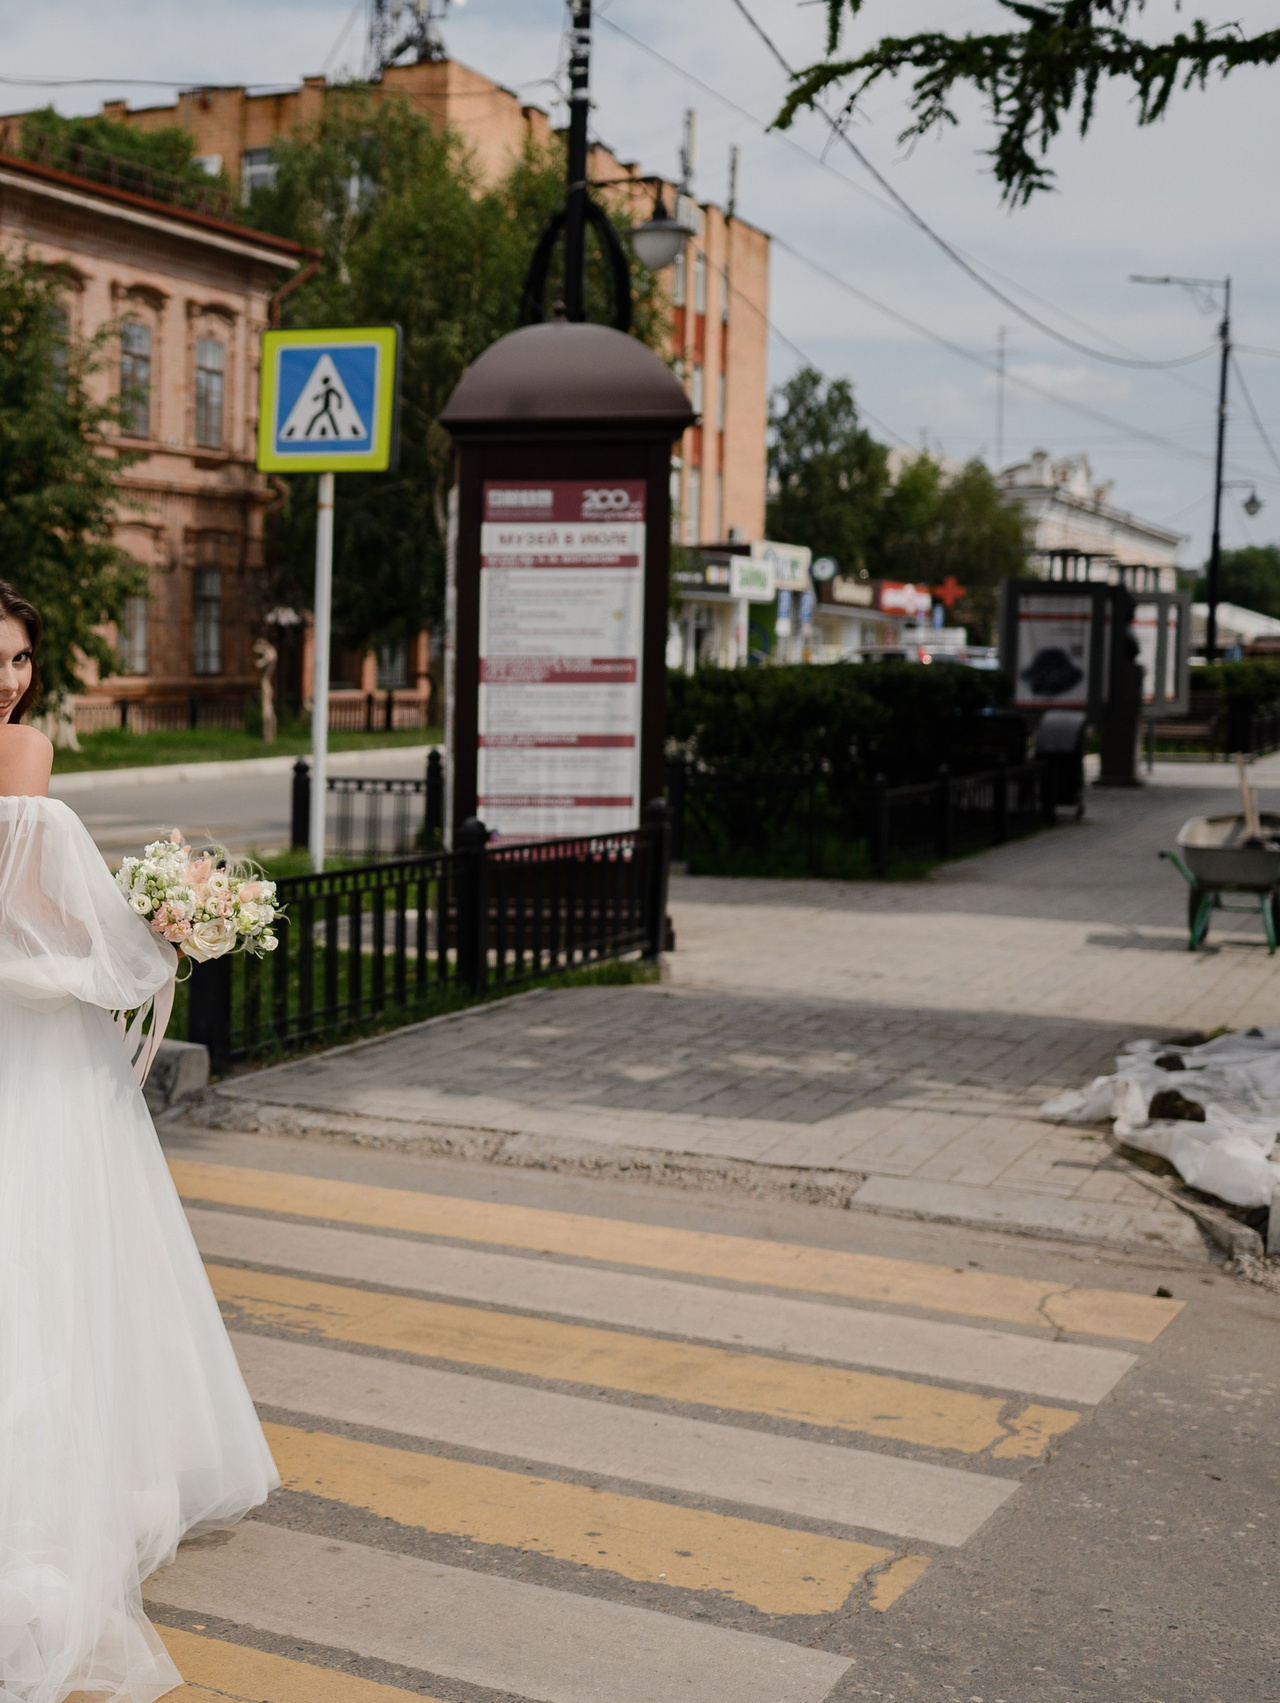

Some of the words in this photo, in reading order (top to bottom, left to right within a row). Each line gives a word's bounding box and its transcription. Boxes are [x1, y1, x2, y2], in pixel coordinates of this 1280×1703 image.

[582, 488, 631, 511] 200
[499, 530, 559, 545] МУЗЕЙ
[564, 533, 575, 545] В
[580, 532, 629, 545] ИЮЛЕ
